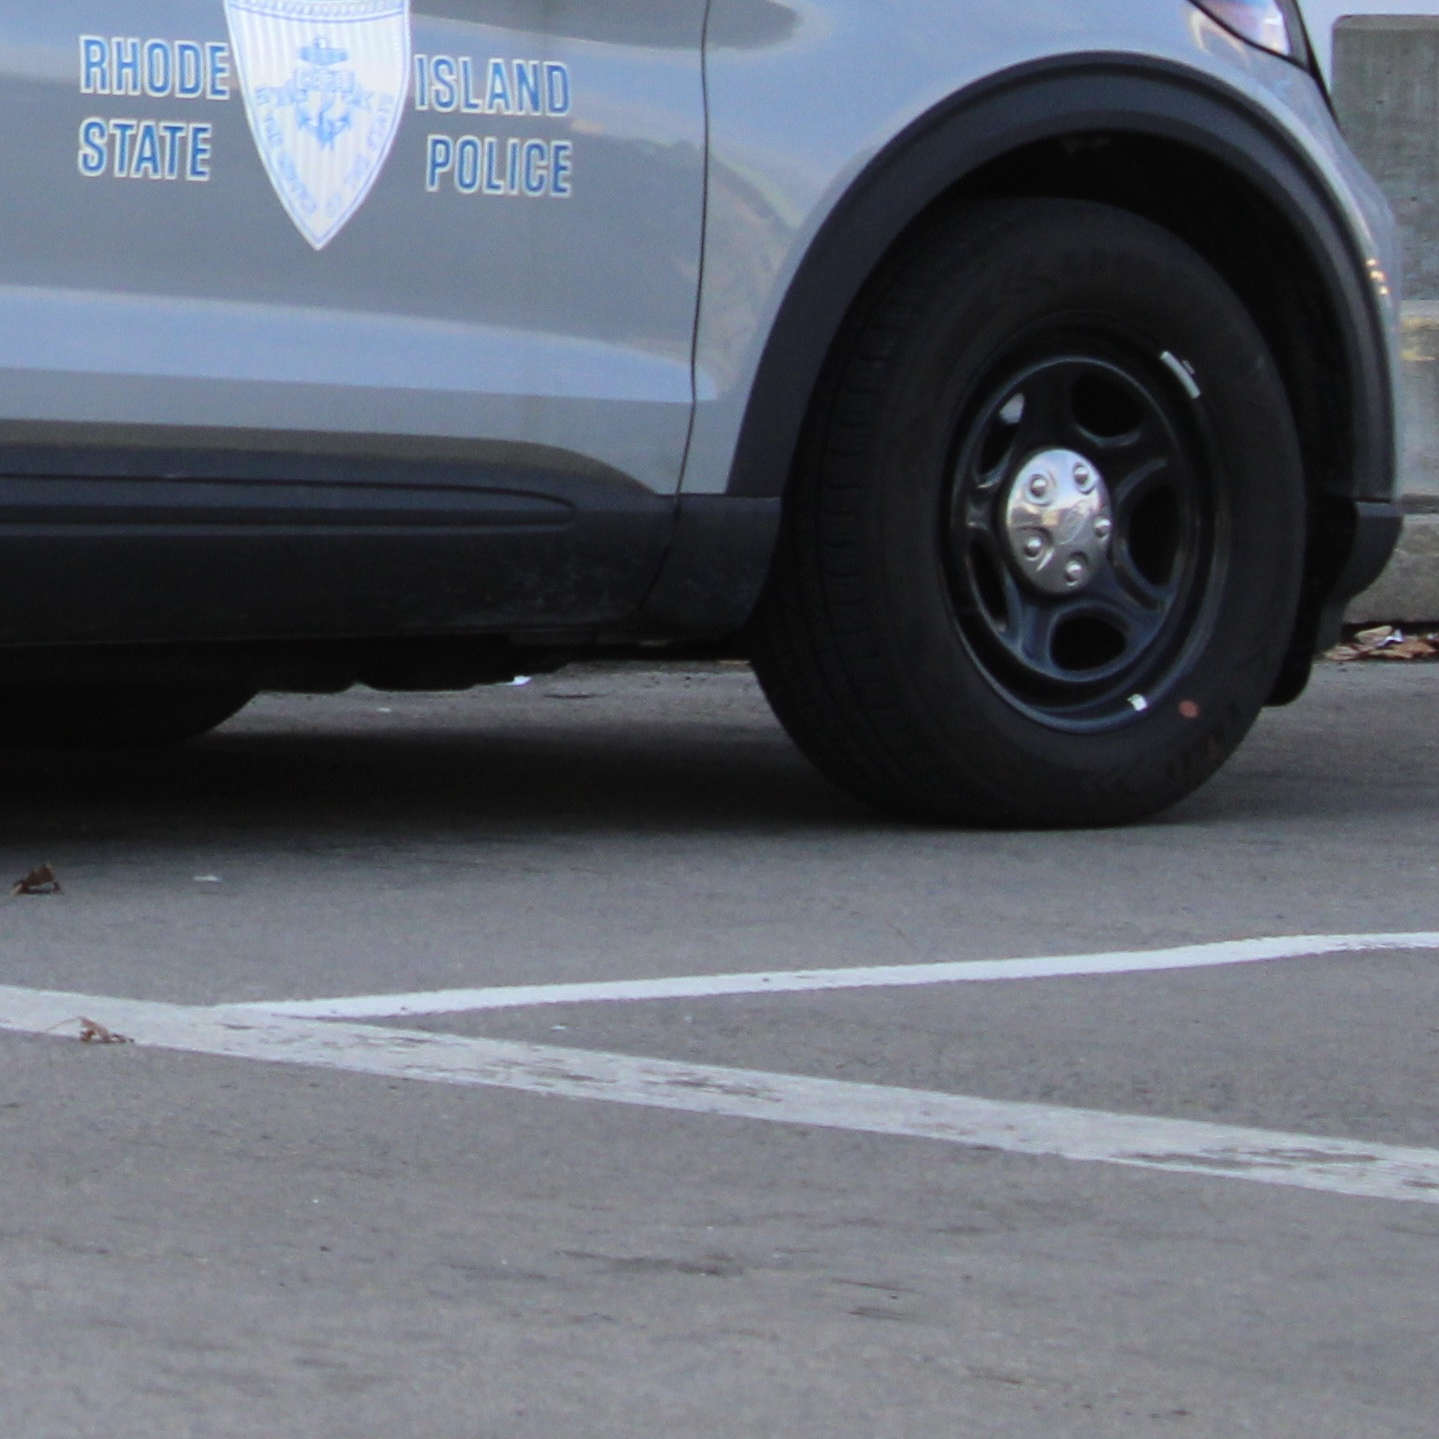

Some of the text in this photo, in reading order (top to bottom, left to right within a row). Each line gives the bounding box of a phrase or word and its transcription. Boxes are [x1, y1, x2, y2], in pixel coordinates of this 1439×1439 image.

[78, 34, 571, 117] RHODE ISLAND
[77, 117, 213, 182] STATE
[425, 134, 572, 199] POLICE
